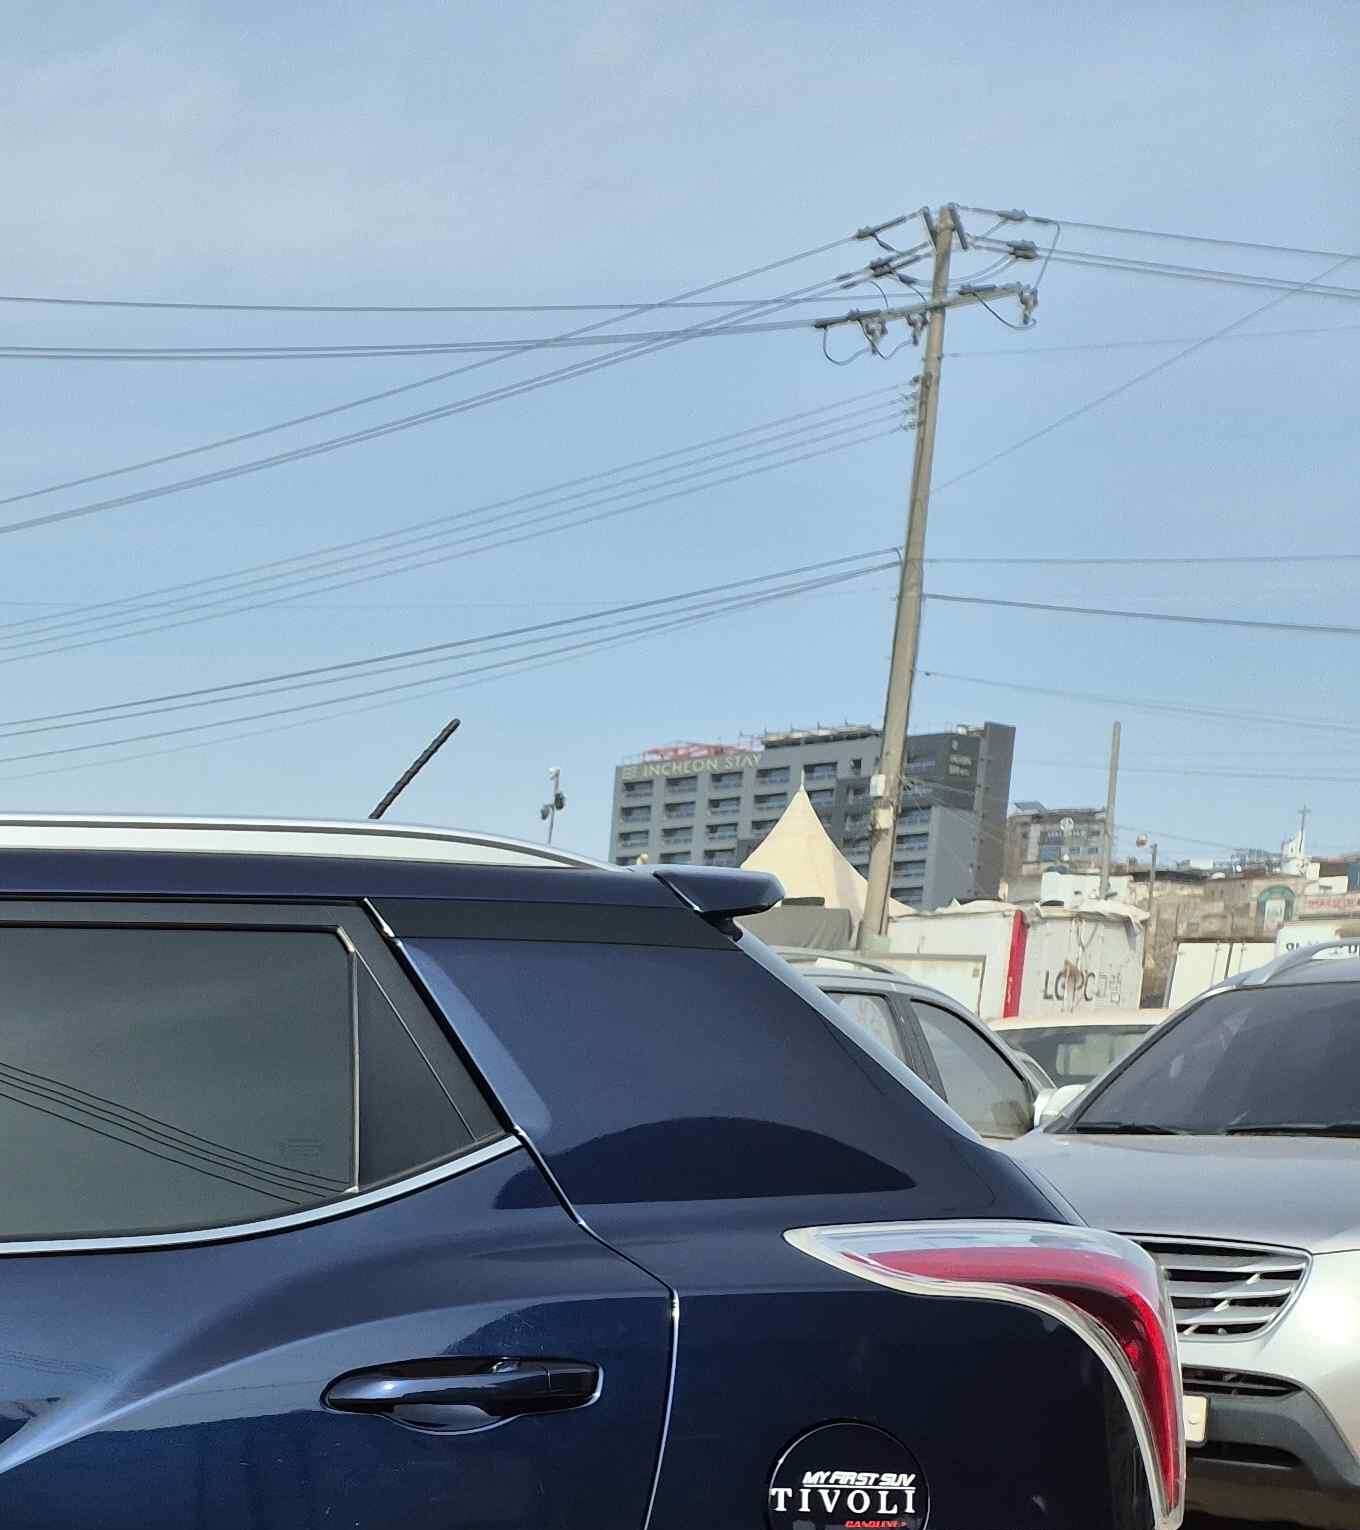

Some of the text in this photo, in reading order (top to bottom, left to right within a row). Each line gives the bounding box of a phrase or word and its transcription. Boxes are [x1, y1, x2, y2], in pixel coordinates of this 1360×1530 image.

[643, 759, 719, 778] INCHEON
[725, 752, 761, 769] STAY
[802, 1471, 832, 1484] MY
[829, 1471, 880, 1486] FIRST
[769, 1487, 916, 1514] TIVOLI
